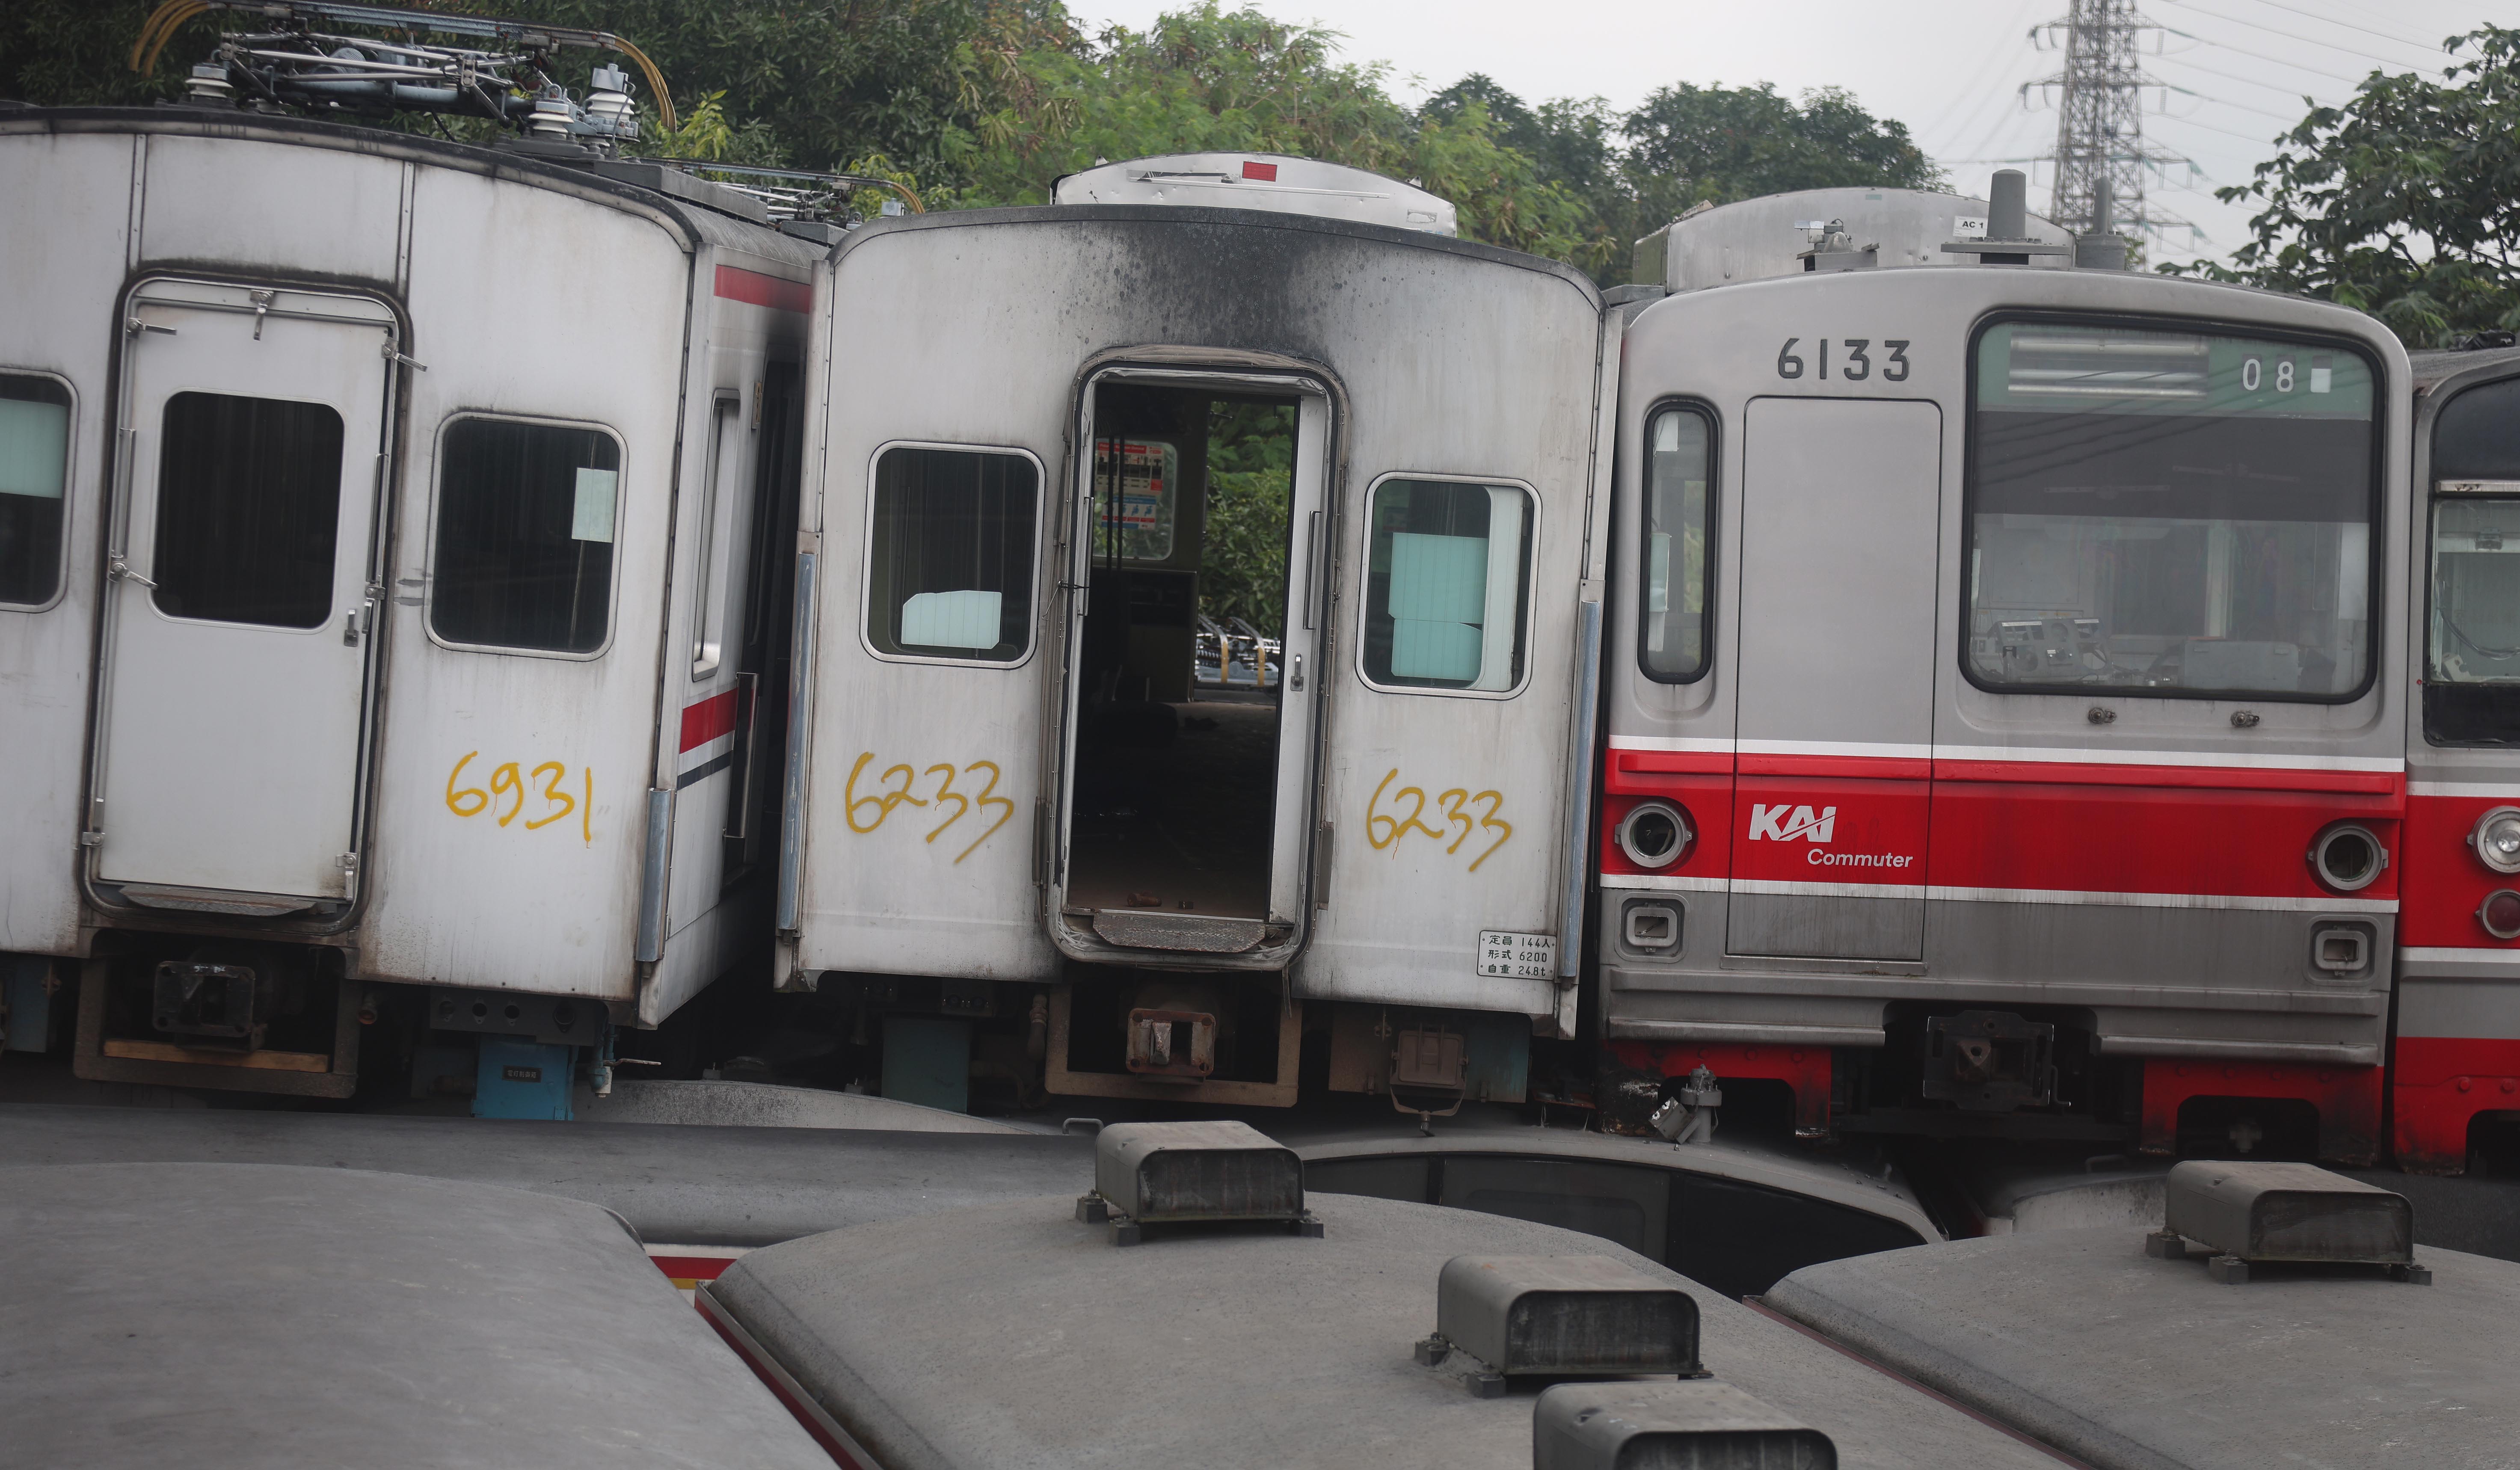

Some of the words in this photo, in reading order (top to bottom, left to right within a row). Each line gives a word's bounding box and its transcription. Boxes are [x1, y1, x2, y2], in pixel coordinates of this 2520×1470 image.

[1778, 338, 1910, 382] 6133
[446, 750, 593, 844] 6931
[845, 751, 1014, 865] 6233
[1366, 768, 1512, 872] 6233
[1748, 803, 1837, 843] KAI
[1807, 848, 1913, 868] Commuter
[1488, 934, 1512, 946] 定員
[1488, 949, 1512, 960] 形式
[1519, 951, 1548, 963] 6200
[1488, 963, 1511, 974] 自重
